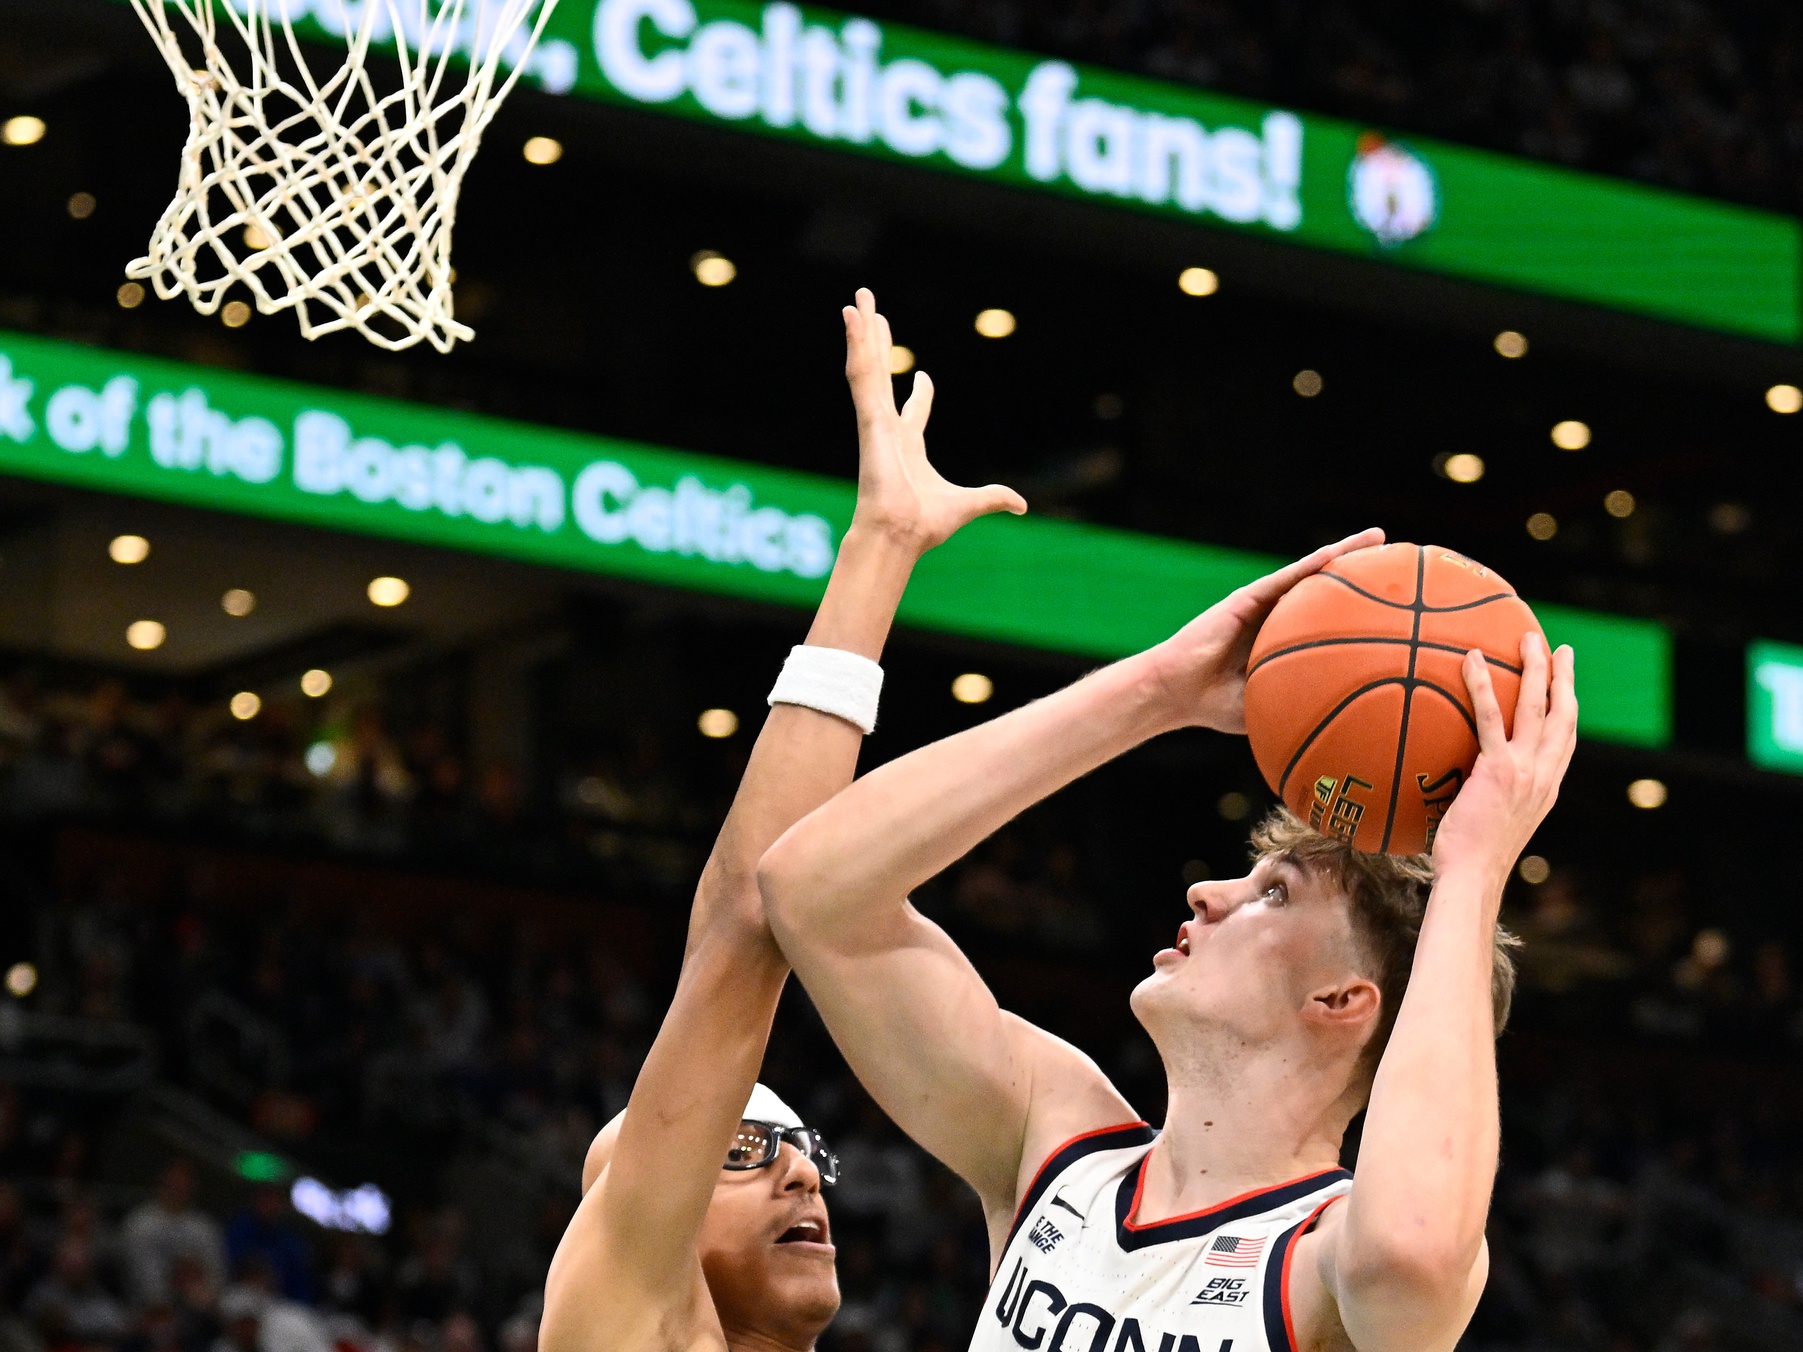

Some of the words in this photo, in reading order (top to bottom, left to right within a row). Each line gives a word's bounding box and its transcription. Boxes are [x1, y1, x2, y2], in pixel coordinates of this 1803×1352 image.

[594, 0, 1011, 170] Celtics
[1018, 59, 1302, 231] fans!
[45, 374, 139, 458] of
[147, 388, 283, 483] the
[292, 409, 565, 532] Boston
[572, 459, 835, 579] Celtics
[1040, 1221, 1065, 1245] THE
[1206, 1277, 1247, 1290] BIG
[1195, 1289, 1250, 1303] EAST
